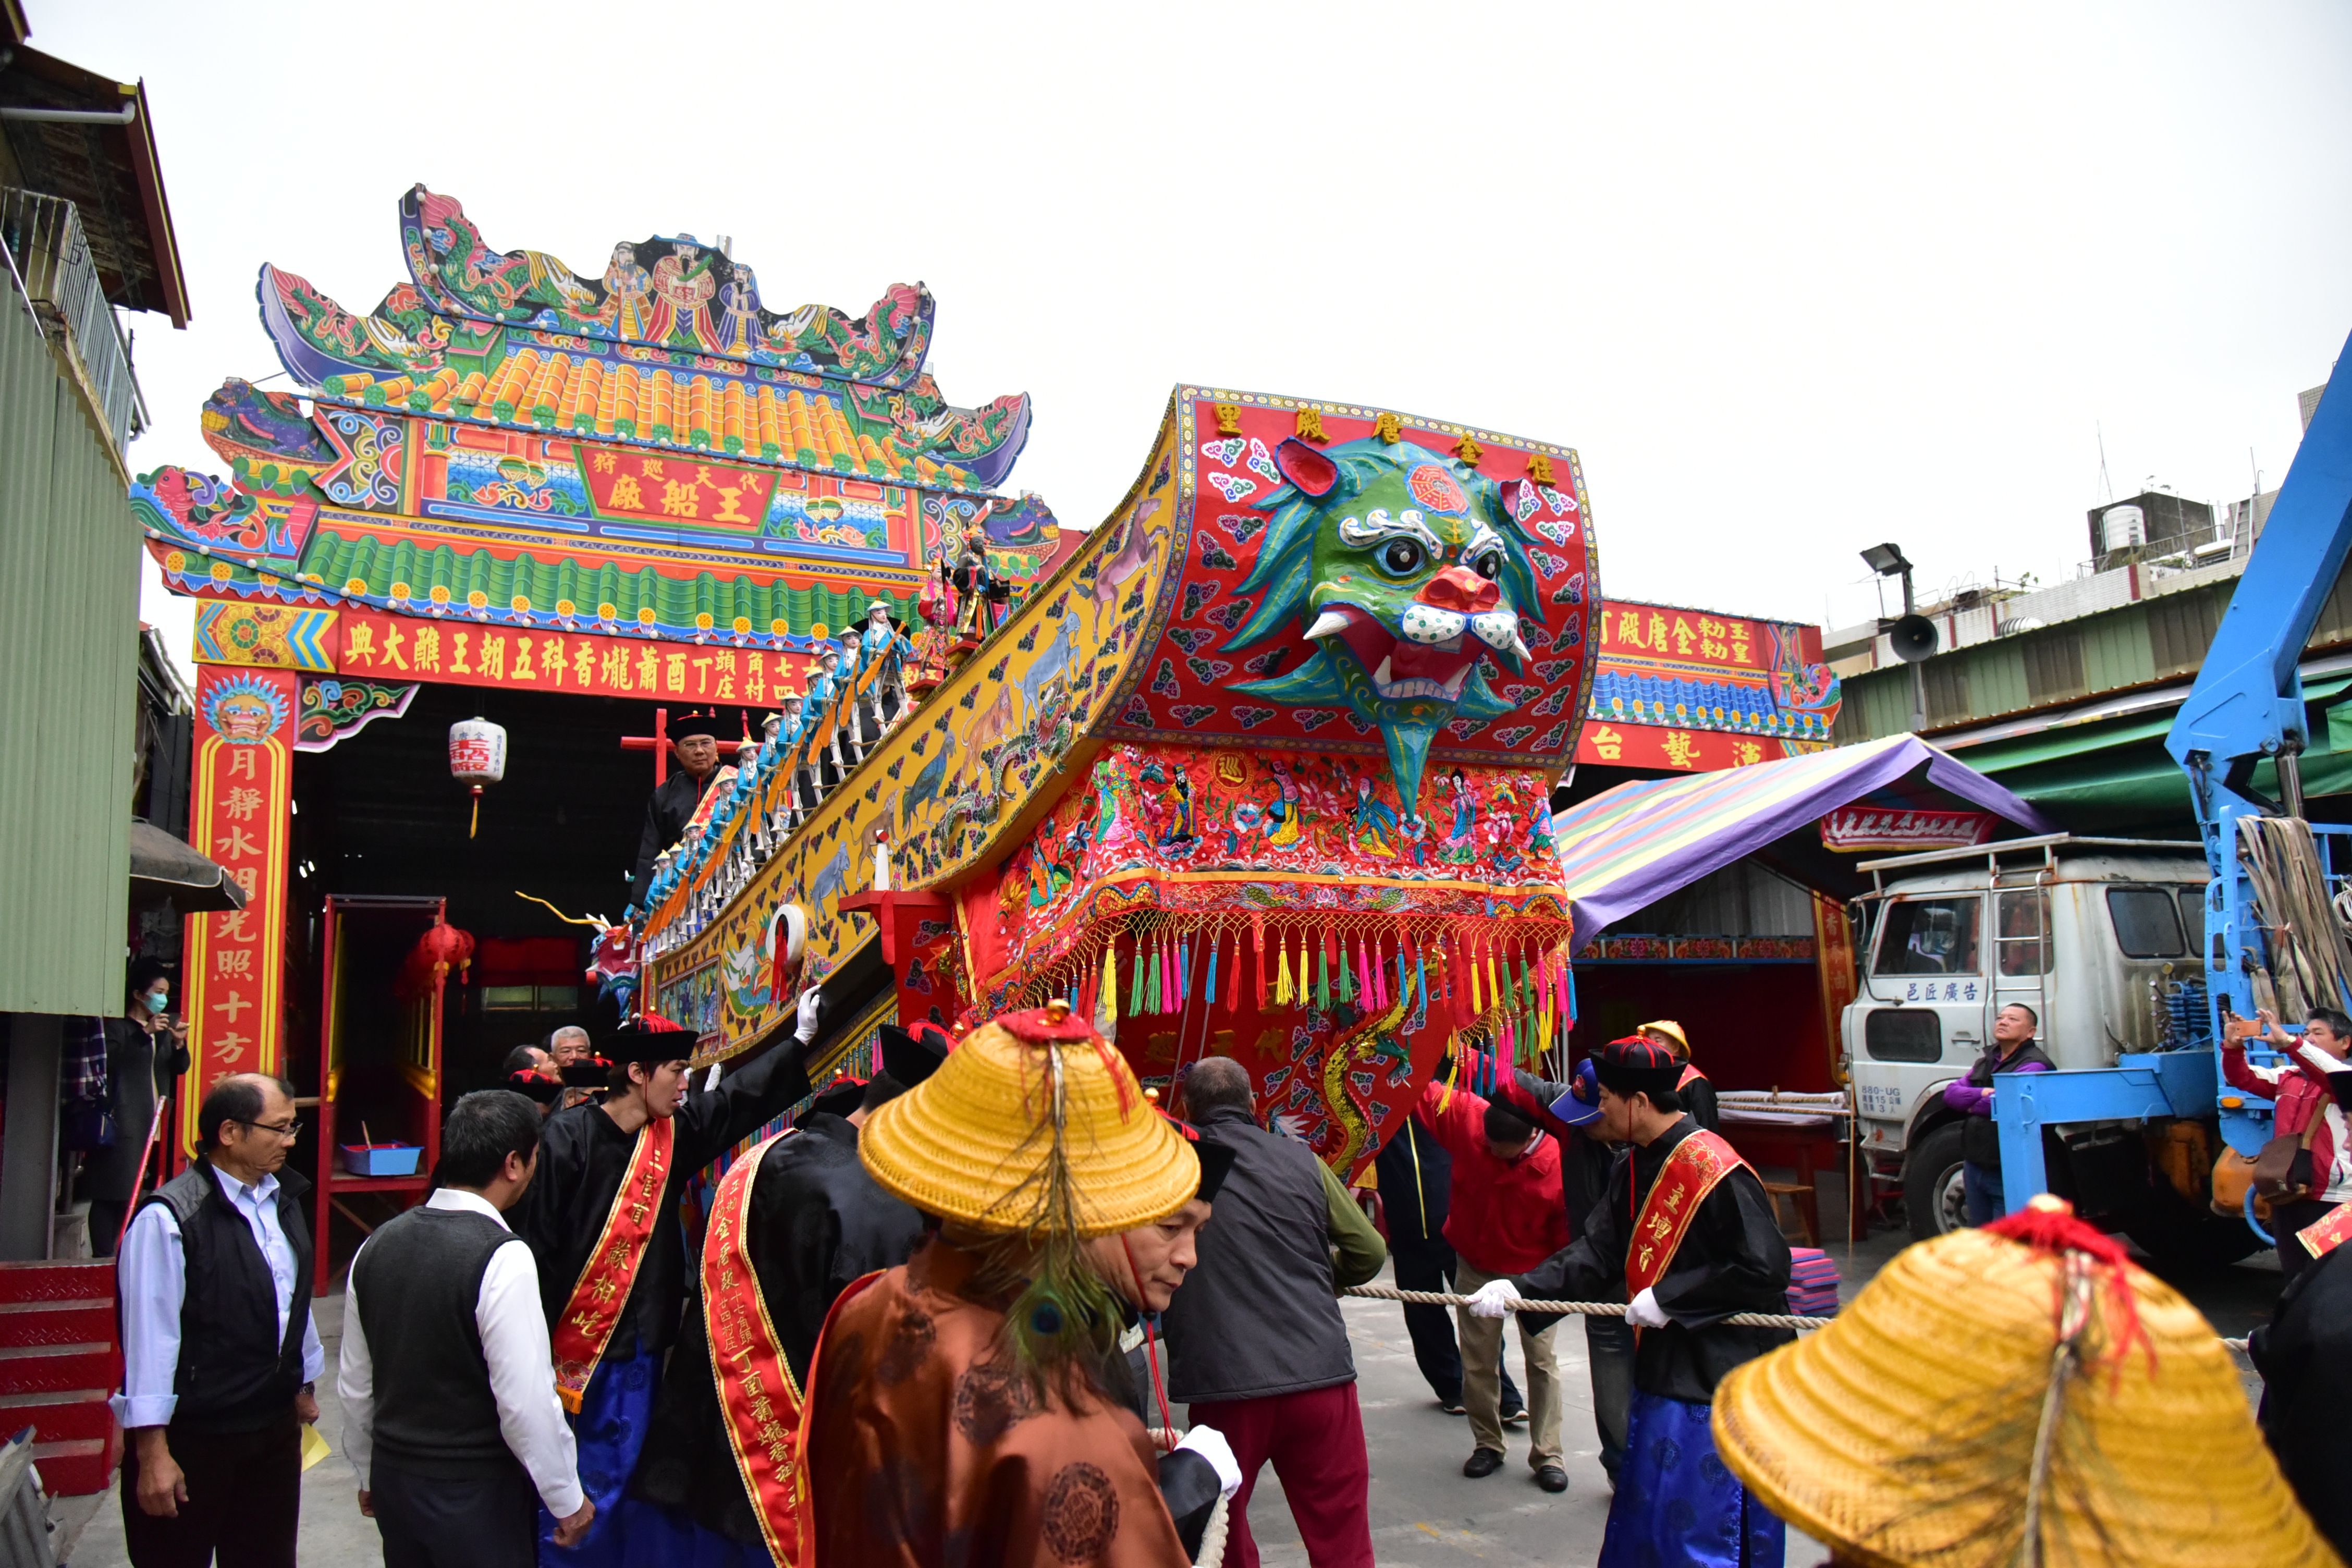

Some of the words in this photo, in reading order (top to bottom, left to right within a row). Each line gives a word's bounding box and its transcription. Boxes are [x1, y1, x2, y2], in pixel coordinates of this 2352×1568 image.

[593, 451, 763, 495] 代天巡狩
[608, 473, 751, 524] 王船廠
[1907, 982, 1978, 1001] 邑匠廣告
[1861, 1085, 1901, 1096] 880-UG
